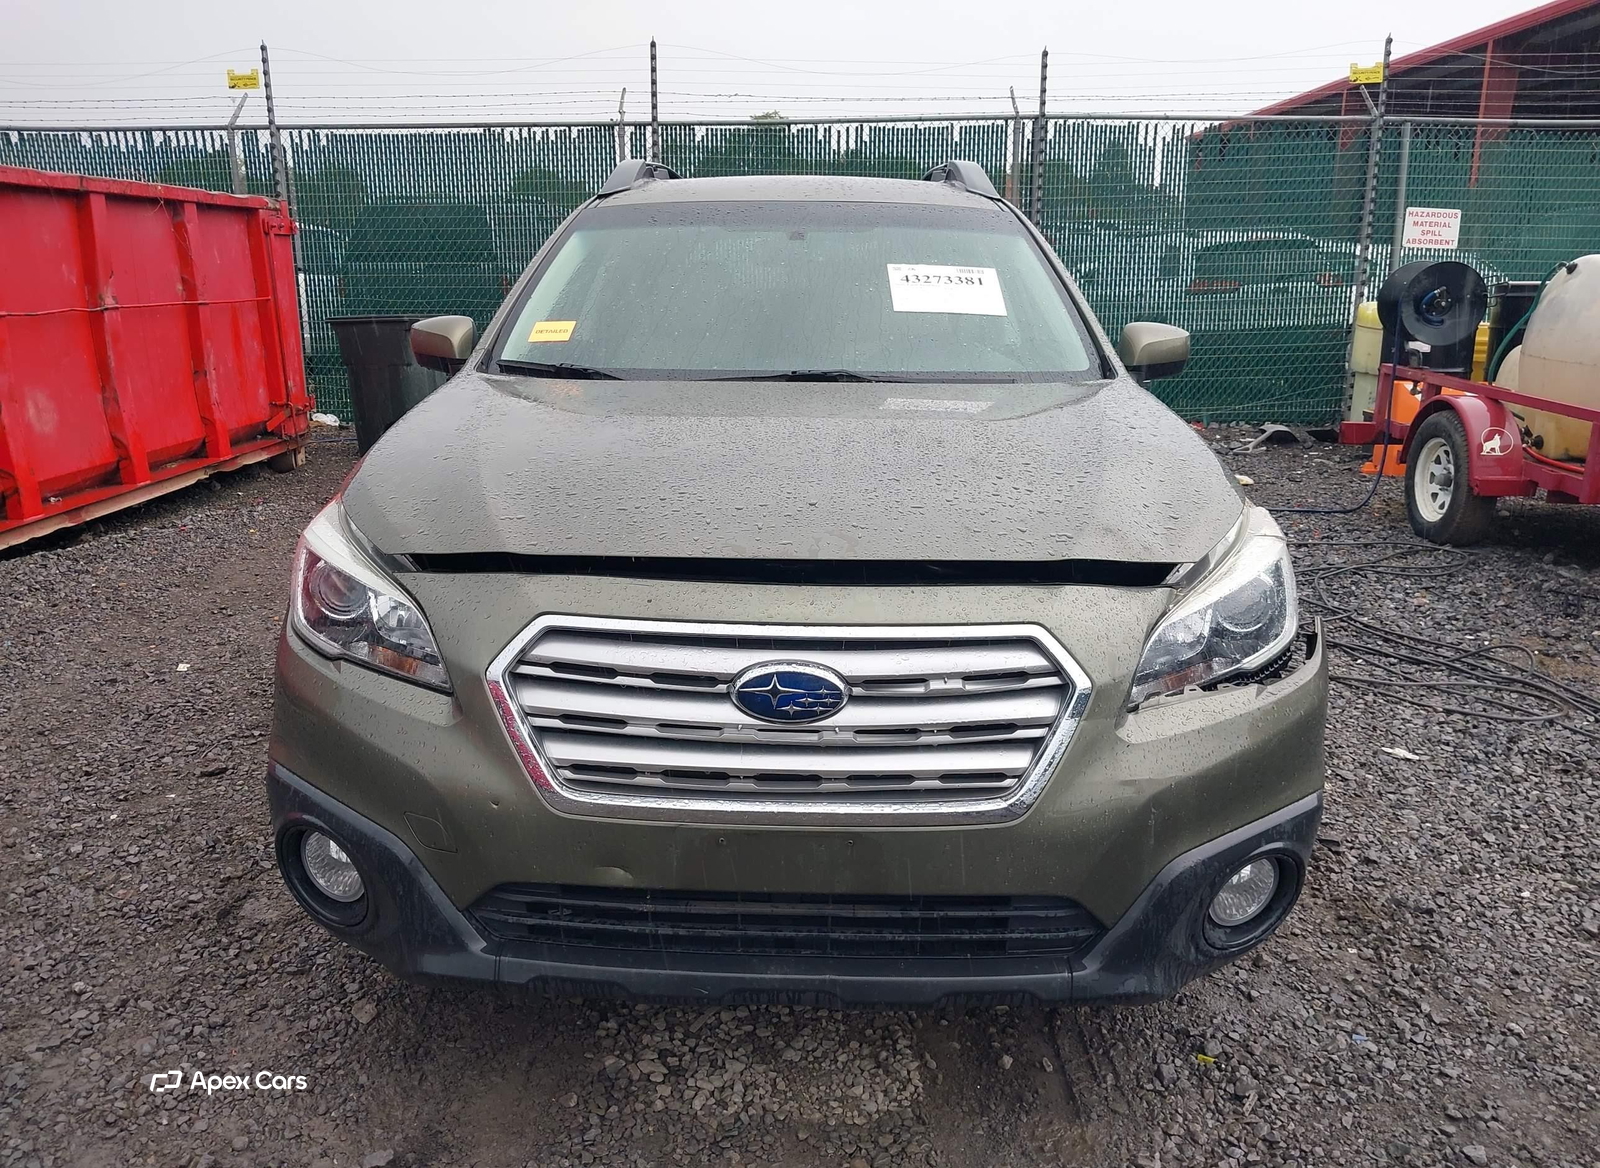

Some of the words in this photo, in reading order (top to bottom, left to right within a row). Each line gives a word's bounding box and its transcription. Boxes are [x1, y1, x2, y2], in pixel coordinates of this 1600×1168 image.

[1408, 211, 1459, 219] HAZARDOUS
[1420, 229, 1442, 237] SPILL
[1405, 238, 1456, 246] ABSORBENT
[900, 274, 983, 286] 43273381
